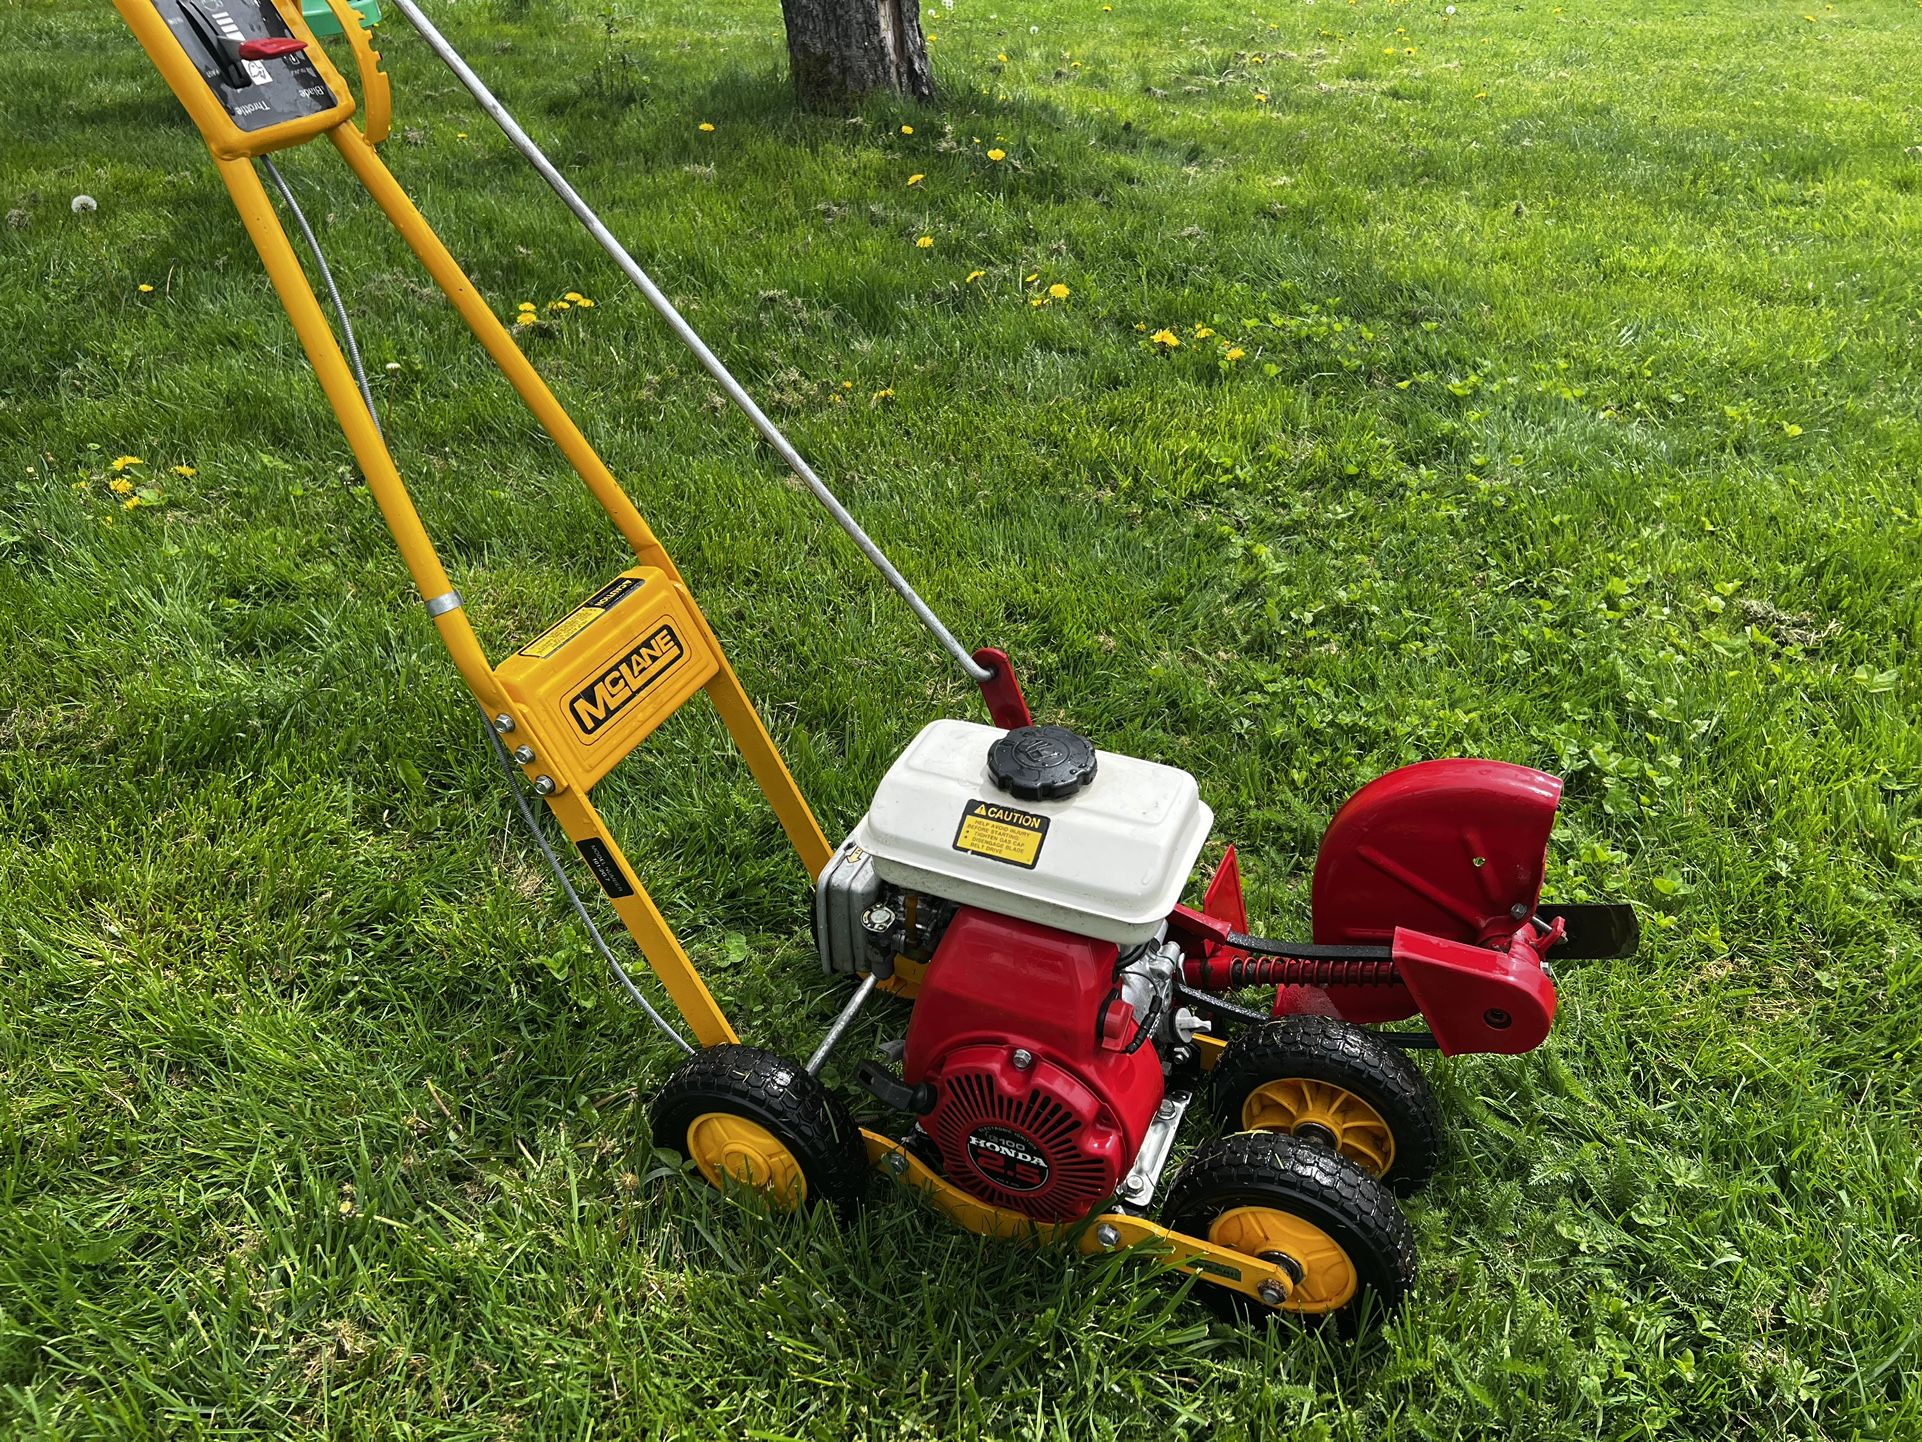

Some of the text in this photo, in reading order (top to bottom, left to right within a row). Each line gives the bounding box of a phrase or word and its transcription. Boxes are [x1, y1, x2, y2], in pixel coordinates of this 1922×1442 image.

[298, 86, 324, 98] Blade
[235, 100, 271, 117] Throttle
[988, 807, 1041, 829] CAUTION
[967, 824, 990, 834] BEFORE
[974, 832, 998, 841] TIGHTEN
[975, 820, 1031, 837] HELP AVOID INJURY
[970, 842, 1003, 855] BELT DRIVE
[972, 837, 1025, 854] DISENGAGE BLADE
[969, 1135, 1048, 1168] HONDA
[977, 1148, 1041, 1184] 2.5
